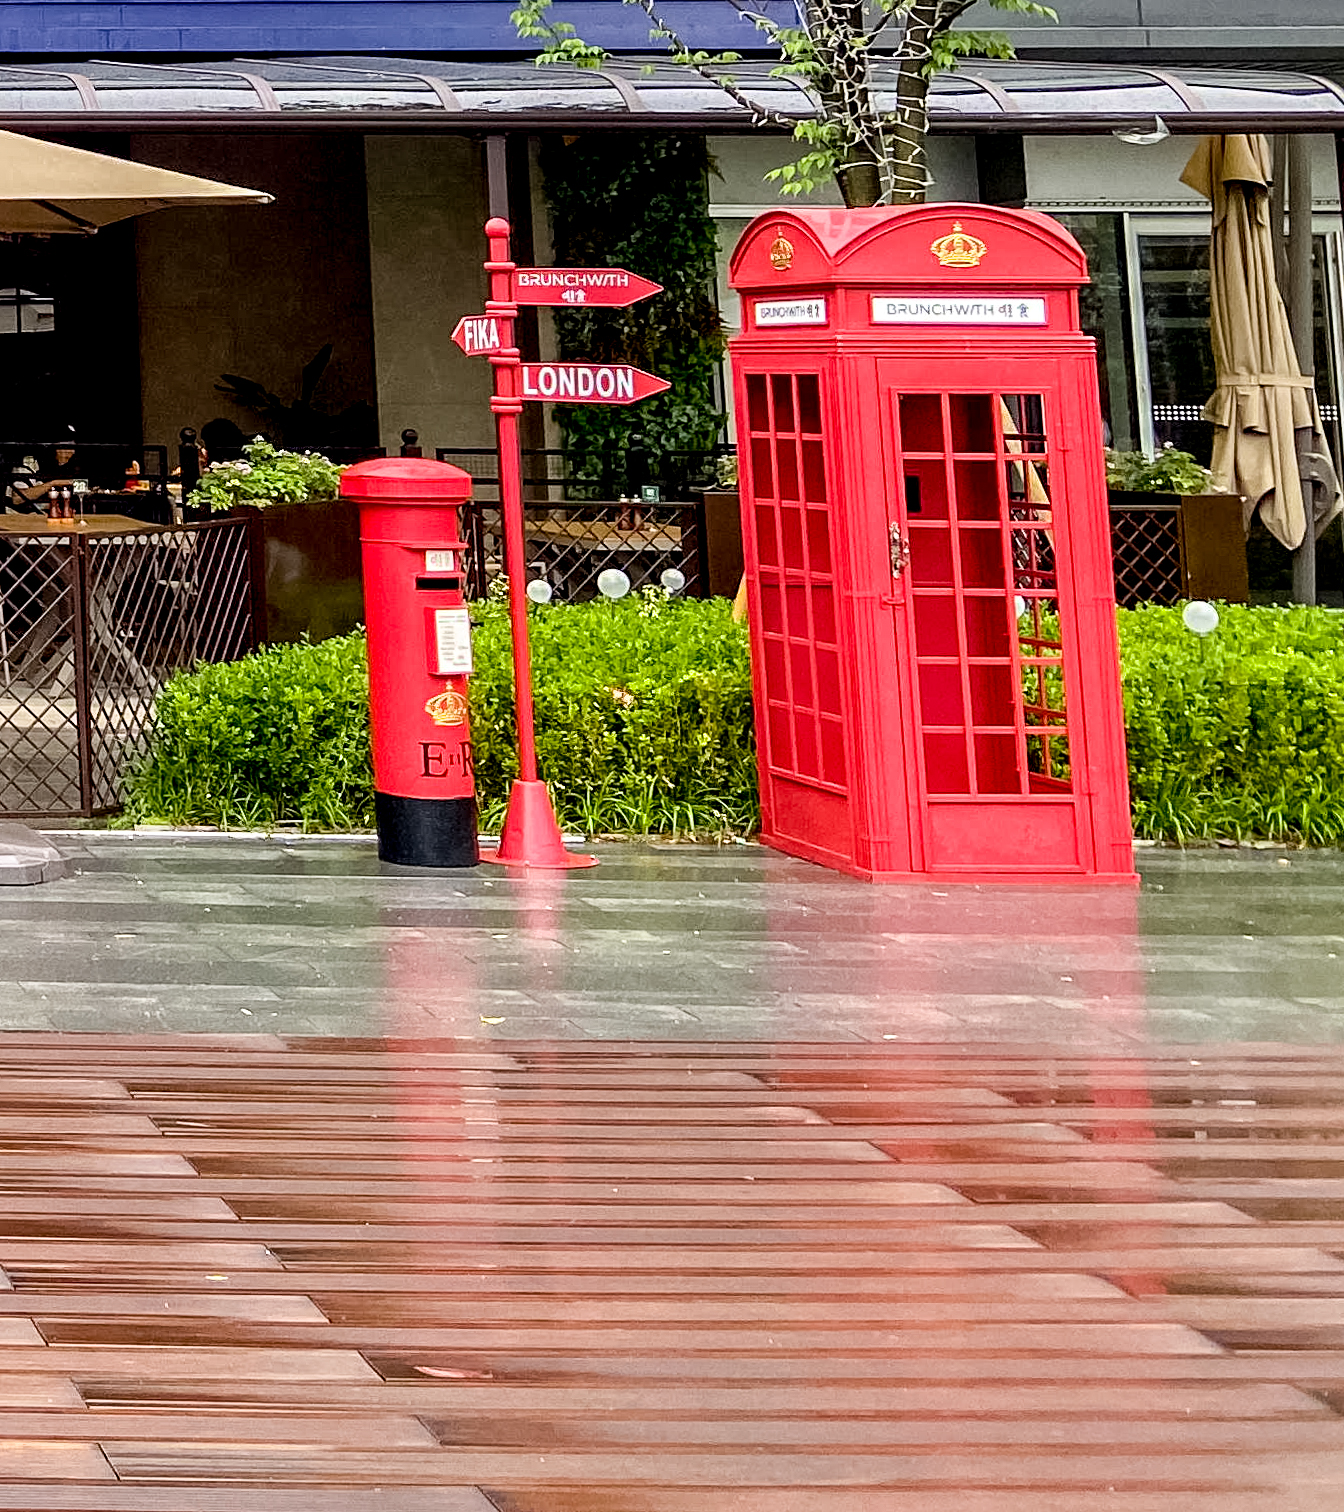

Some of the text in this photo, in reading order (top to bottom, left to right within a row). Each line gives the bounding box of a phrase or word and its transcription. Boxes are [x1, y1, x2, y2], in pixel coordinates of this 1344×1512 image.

[518, 273, 630, 287] BRUNCHWITH
[886, 303, 994, 316] BRUNCHWITH
[463, 318, 500, 352] FIKA
[522, 366, 634, 398] LONDON
